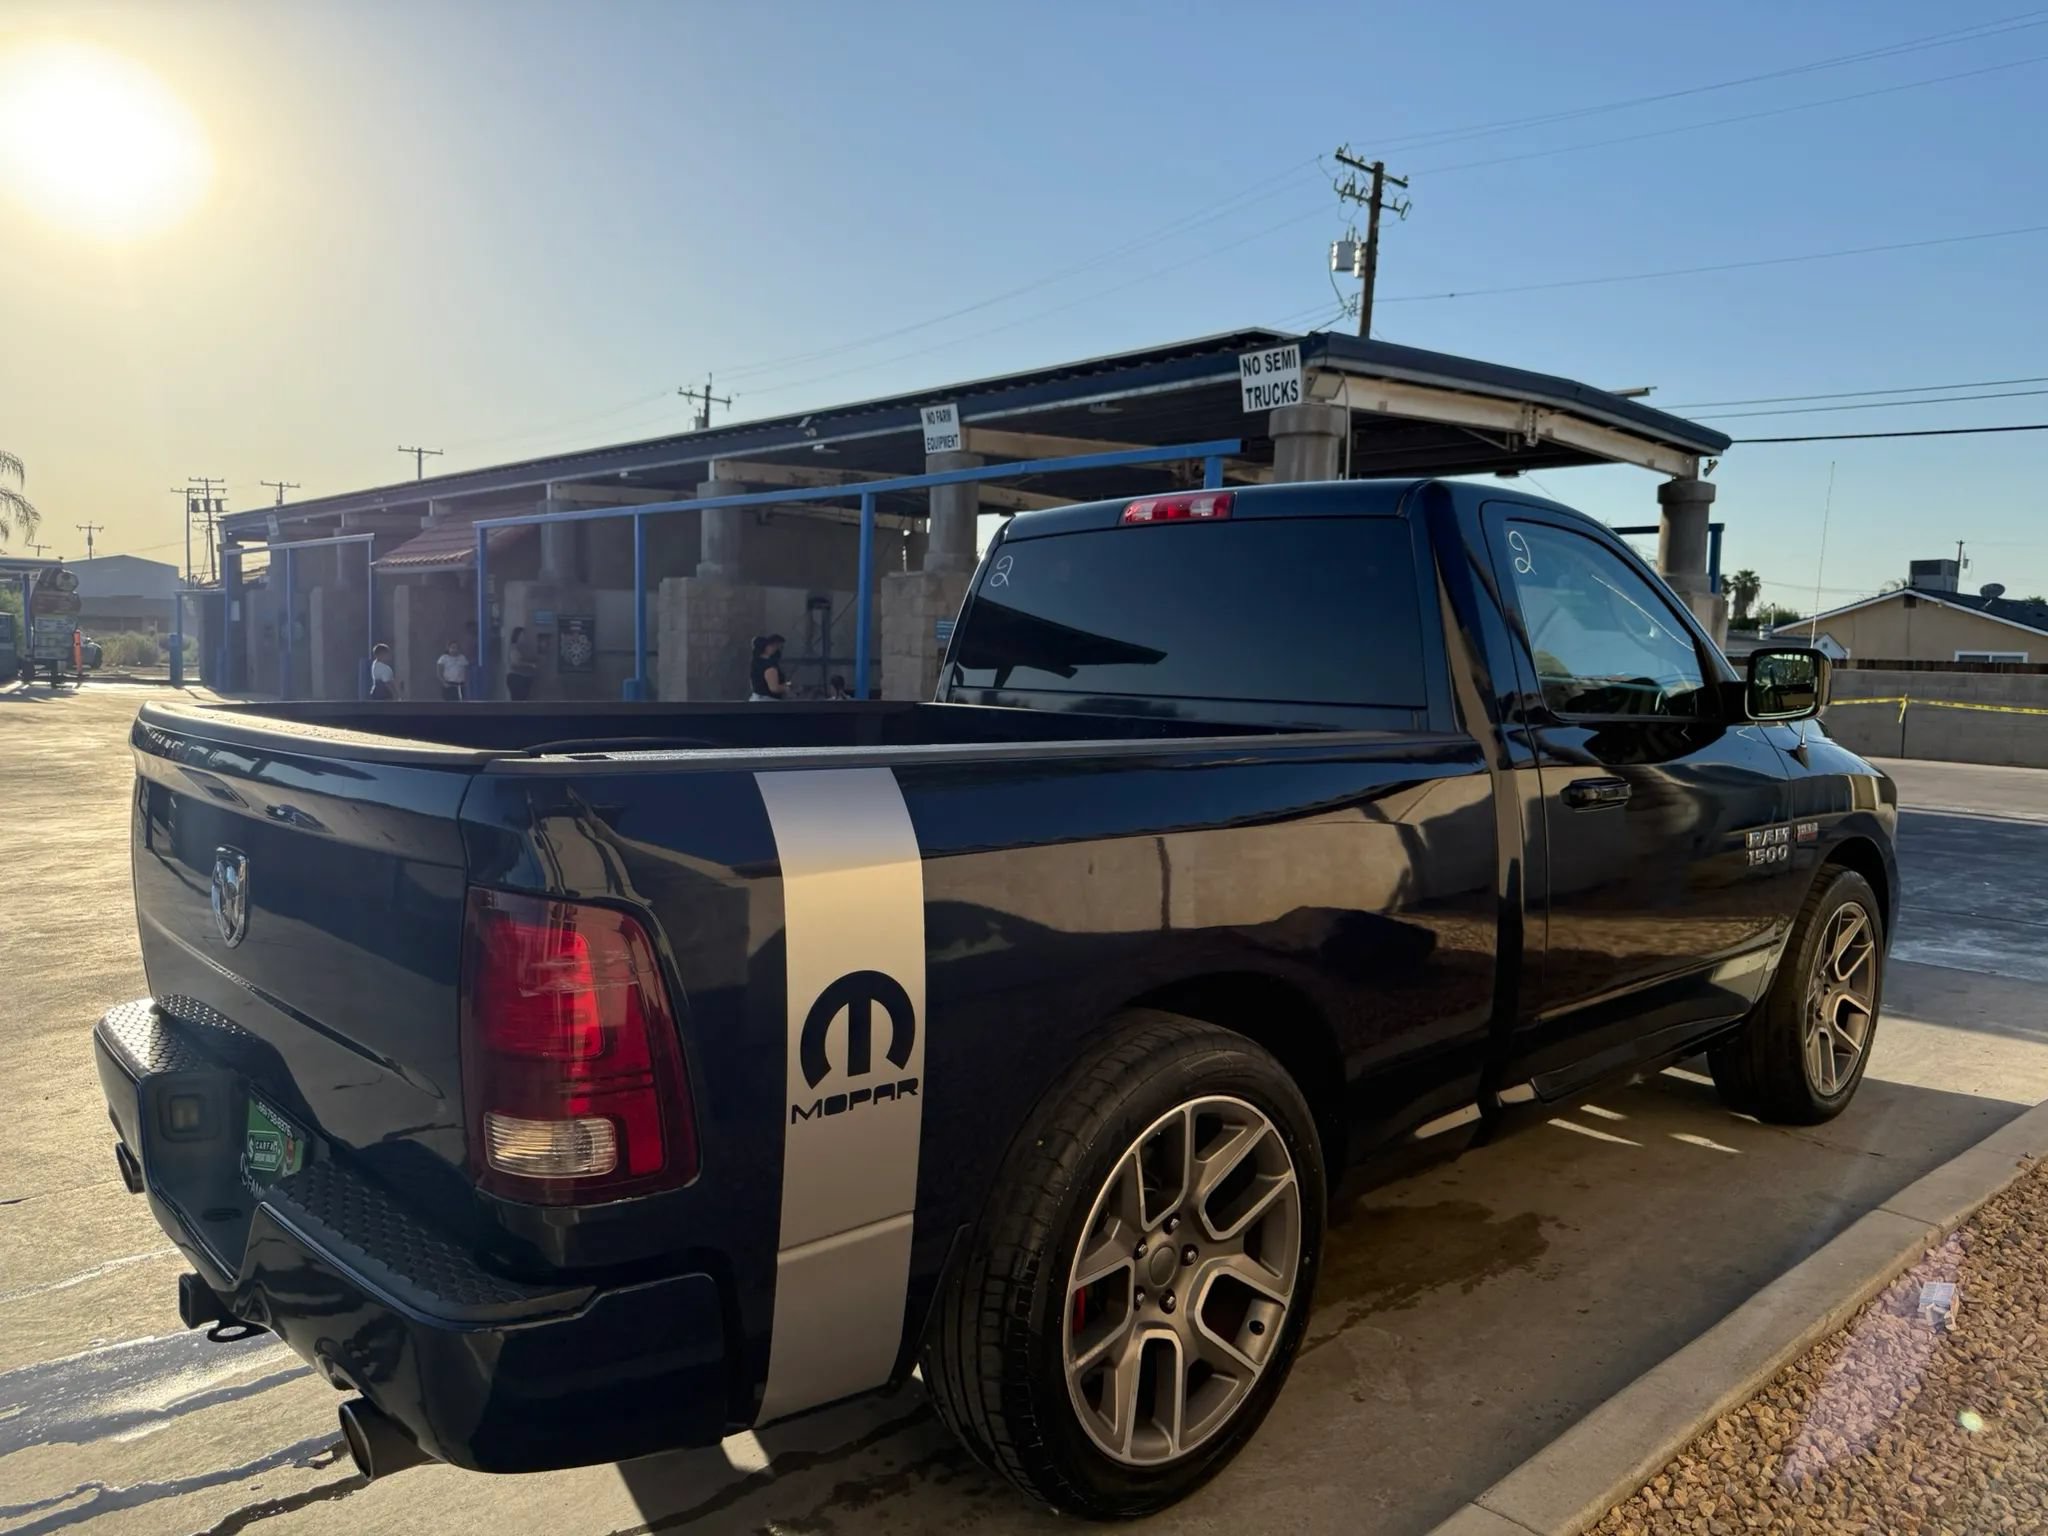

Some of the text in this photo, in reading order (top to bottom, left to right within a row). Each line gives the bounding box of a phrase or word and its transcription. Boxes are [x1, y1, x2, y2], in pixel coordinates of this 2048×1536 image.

[1243, 349, 1296, 377] NO SEMI
[1245, 379, 1299, 409] TRUCKS
[926, 408, 951, 424] NO FARM
[927, 434, 958, 451] EQUIPMENT
[1748, 844, 1789, 866] 1500
[791, 1078, 919, 1124] MOPAR
